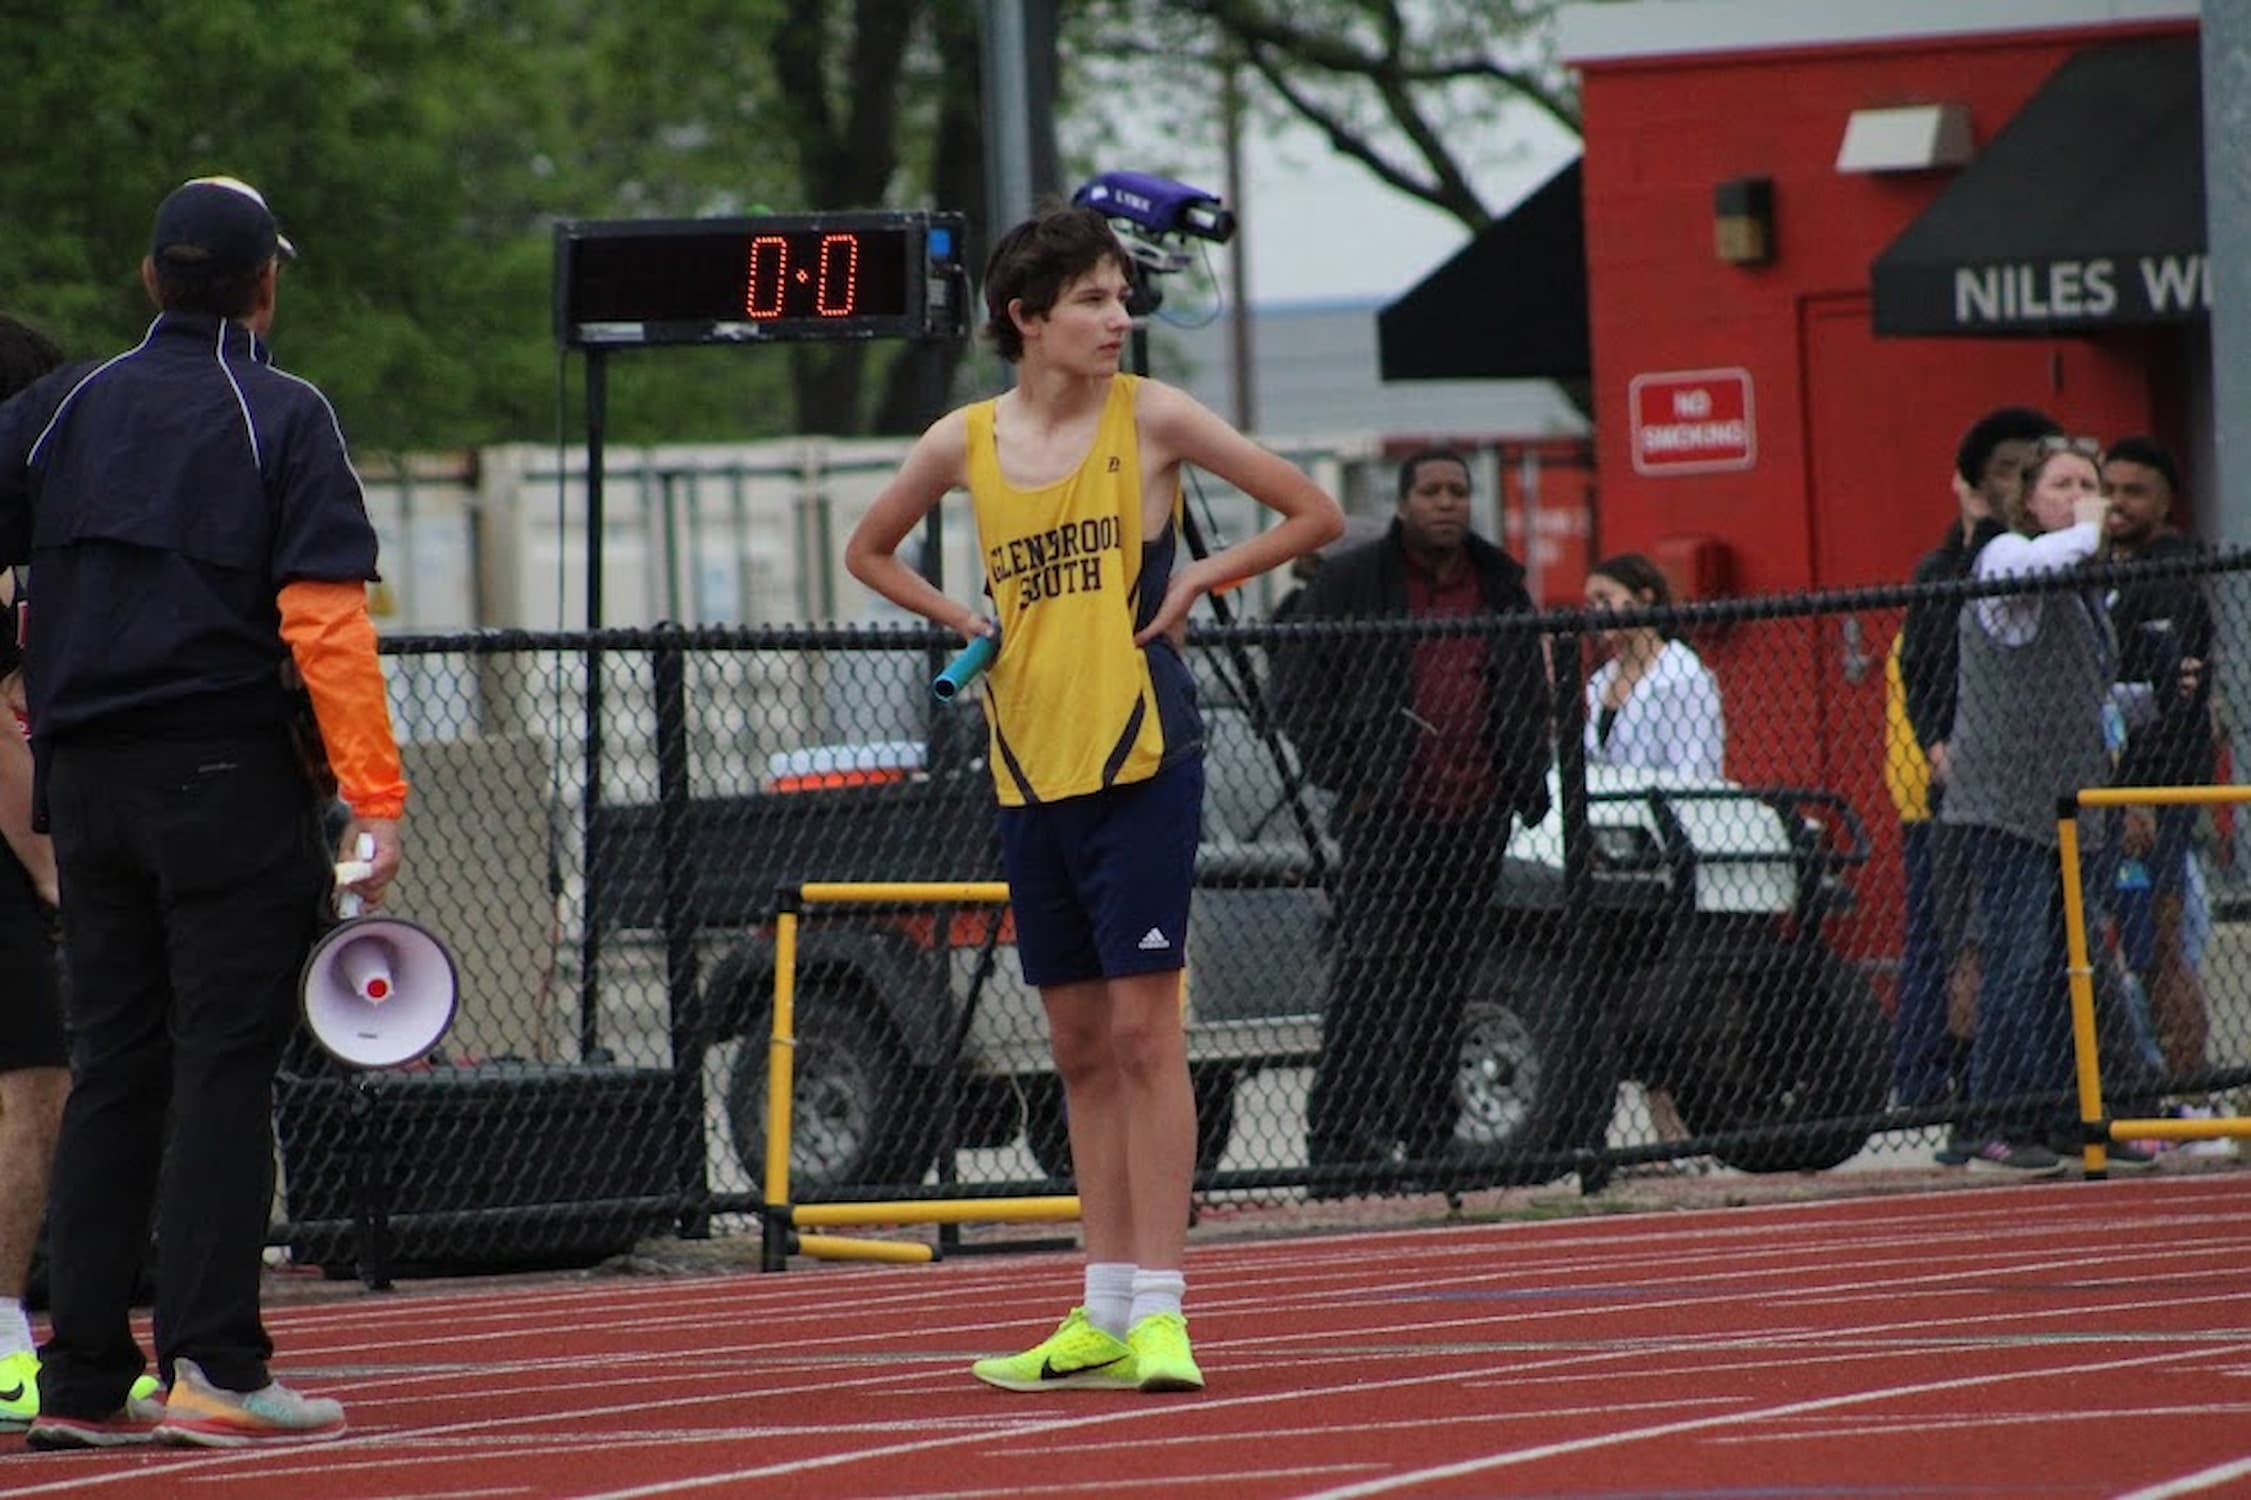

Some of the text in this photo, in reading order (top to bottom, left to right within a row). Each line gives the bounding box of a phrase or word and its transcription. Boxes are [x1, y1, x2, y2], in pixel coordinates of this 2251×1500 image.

[1955, 257, 2119, 323] NILES
[1673, 389, 1712, 418] NO
[1641, 420, 1744, 453] SMOKING
